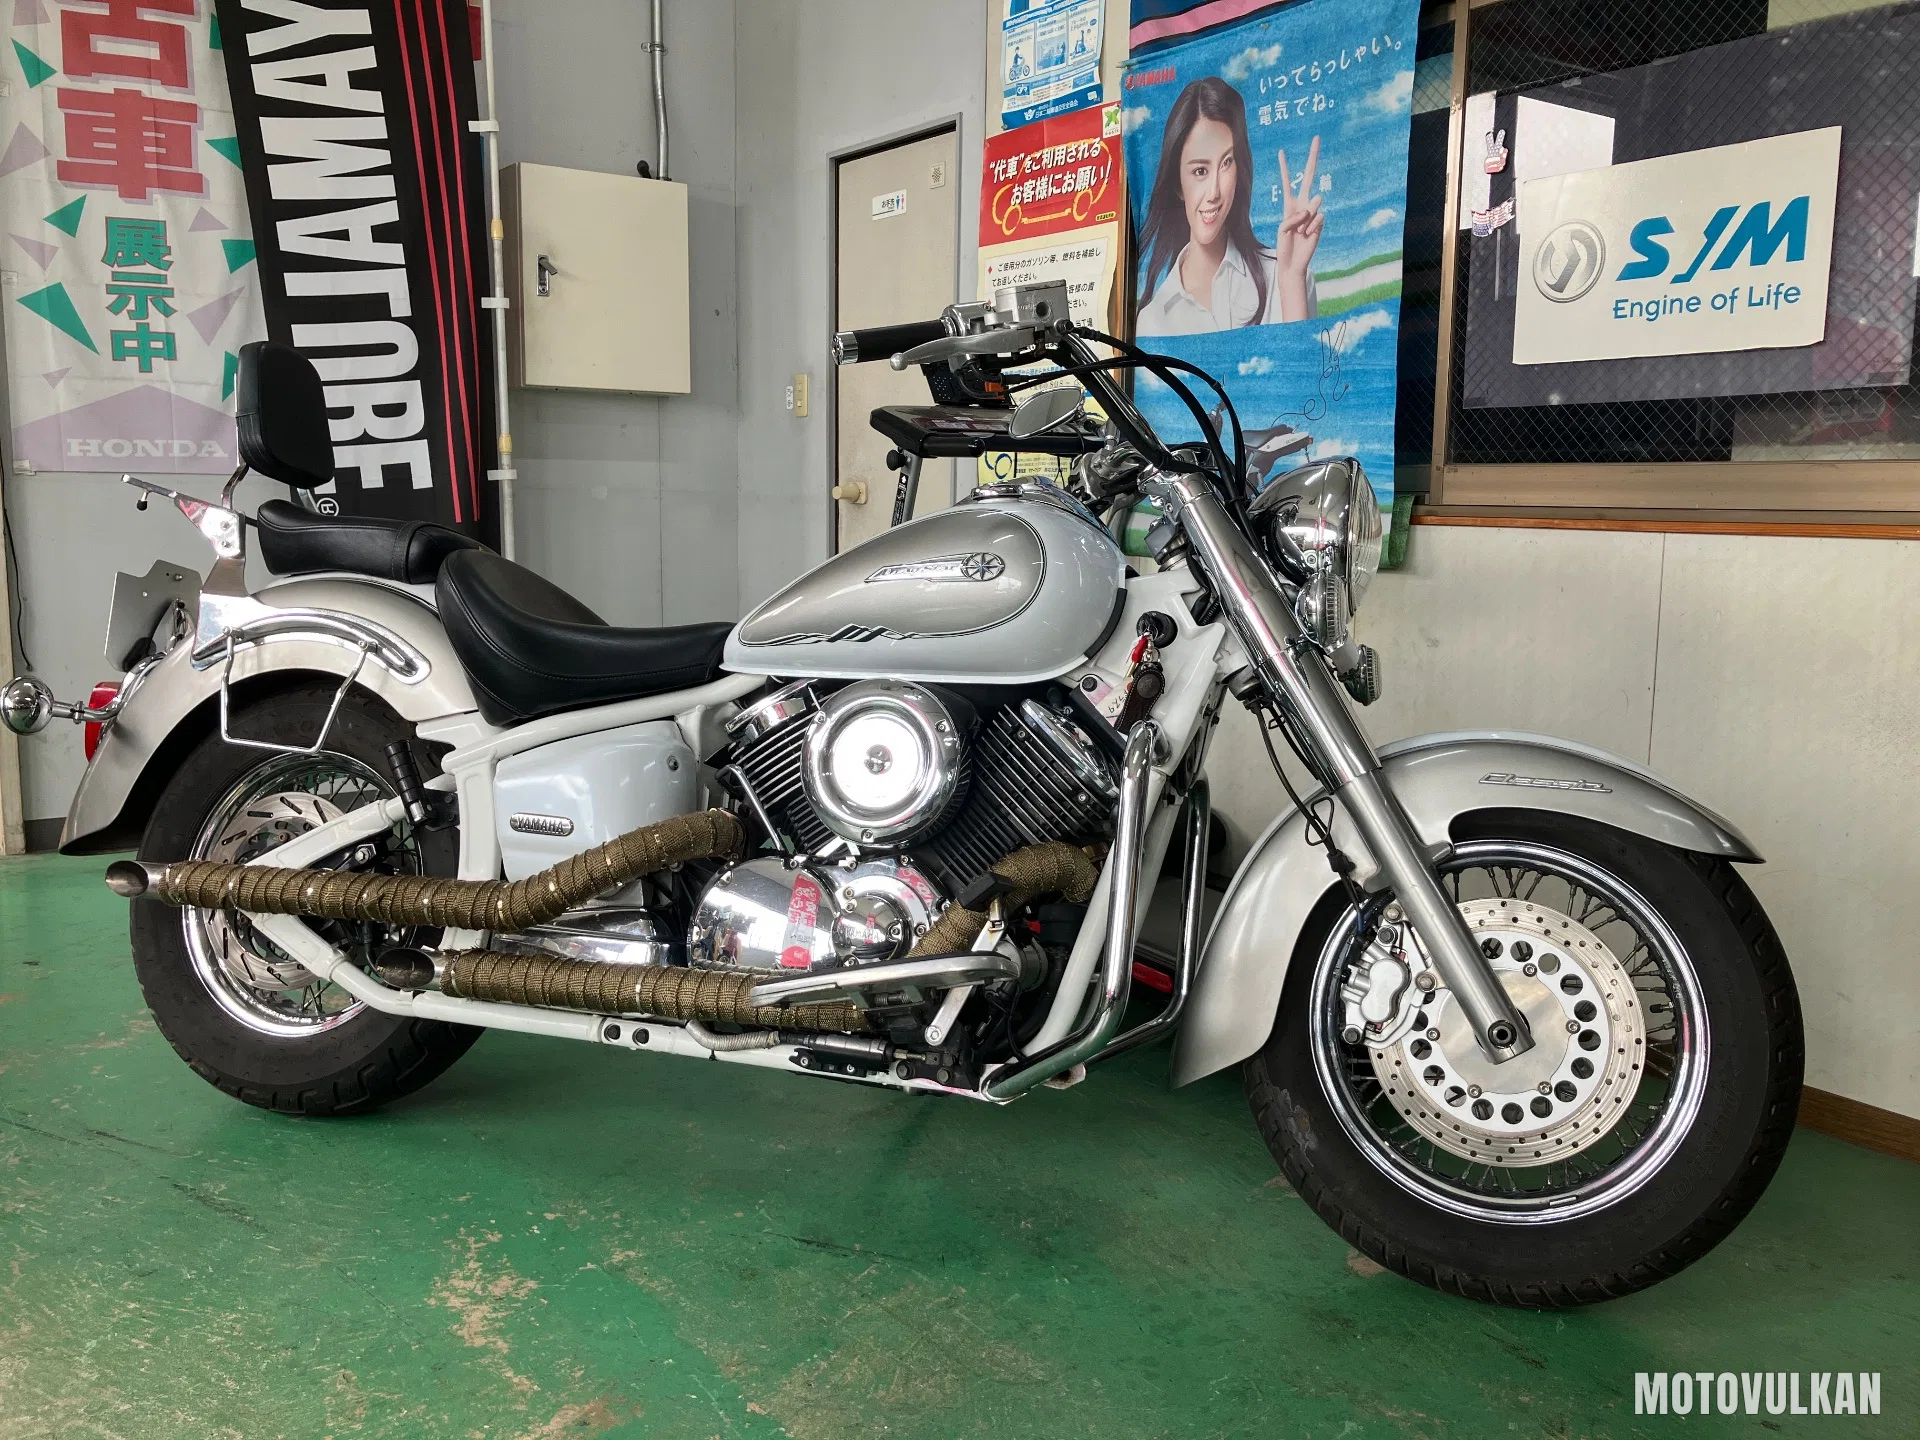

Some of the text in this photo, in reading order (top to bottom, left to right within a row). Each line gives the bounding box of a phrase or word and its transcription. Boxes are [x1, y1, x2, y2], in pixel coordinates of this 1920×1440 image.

[1135, 65, 1176, 88] YAMAHA
[1259, 34, 1402, 94] いってらっしゃい。
[57, 0, 208, 203] 古車
[1258, 93, 1335, 126] 電気でね。
[1616, 195, 1810, 284] SYM
[101, 216, 178, 373] 展示中
[1612, 282, 1801, 322] Engine of Life
[67, 438, 229, 459] HONDA
[1479, 772, 1613, 793] Classic
[517, 816, 565, 834] YAMAHA
